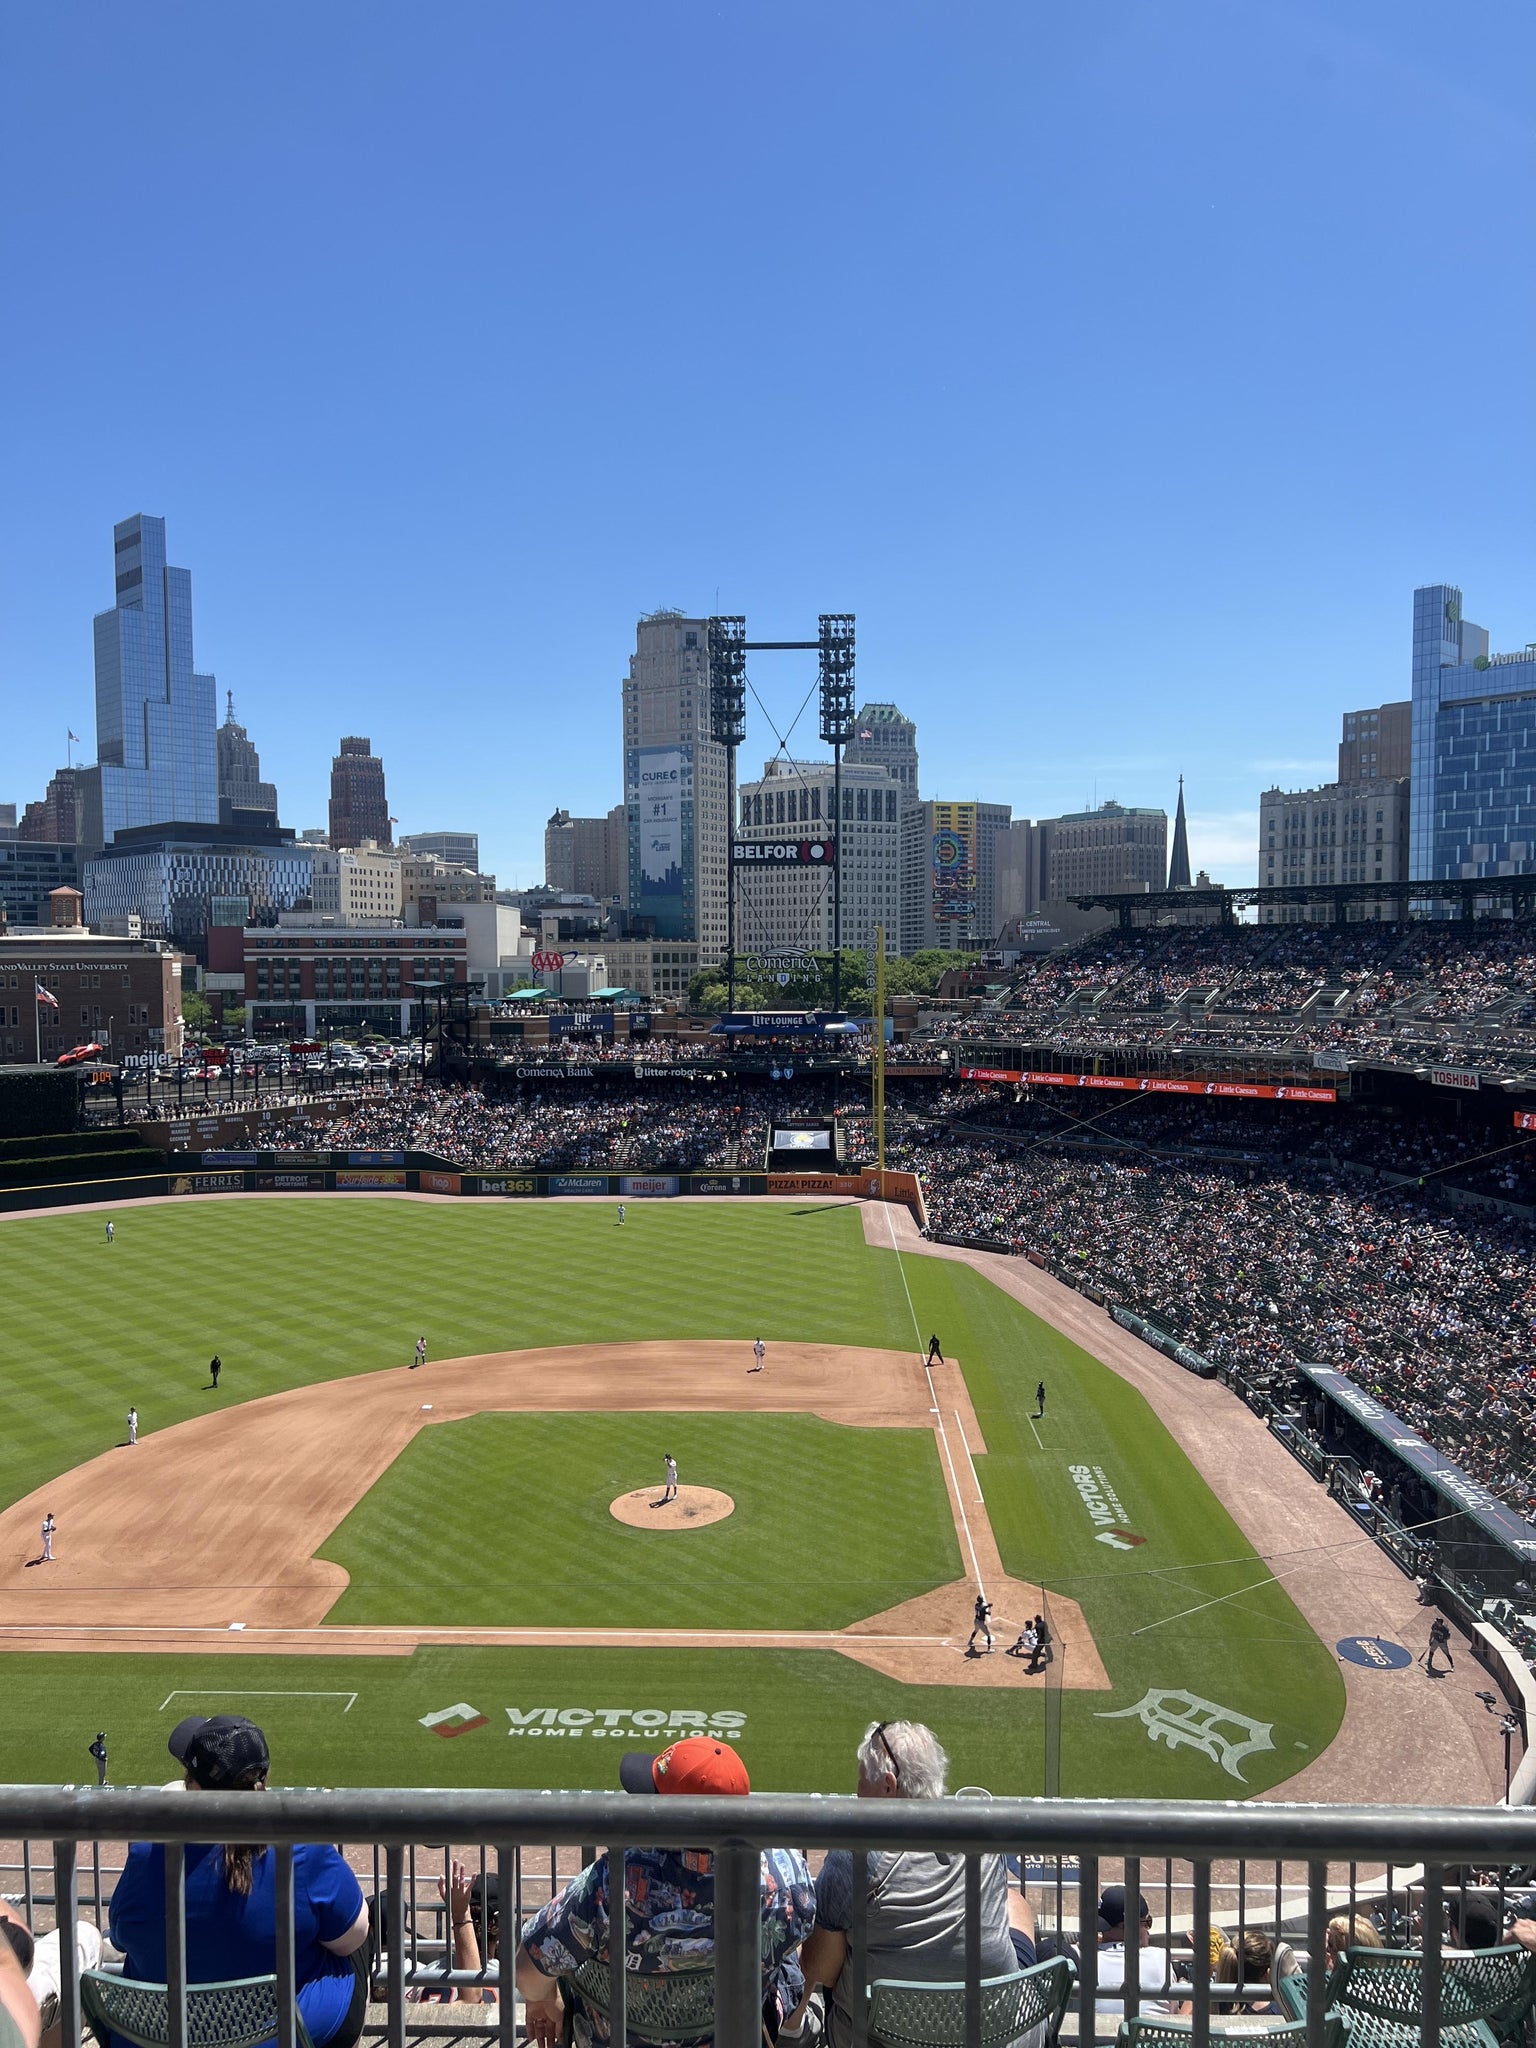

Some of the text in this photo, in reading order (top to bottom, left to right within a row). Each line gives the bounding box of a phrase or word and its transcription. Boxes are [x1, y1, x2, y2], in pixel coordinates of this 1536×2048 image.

[642, 771, 669, 781] CURE
[654, 803, 666, 816] #1
[733, 845, 798, 859] BELFOR
[533, 953, 562, 970] AAA
[747, 973, 822, 987] LANDING
[574, 1013, 591, 1026] Lite
[752, 1015, 803, 1026] Lite LOUNGE
[124, 1049, 174, 1069] meijer
[1146, 1049, 1168, 1060] CLUB
[567, 1068, 594, 1076] Bank
[644, 1067, 697, 1077] litter-robot
[990, 1071, 1008, 1079] Caesars
[1032, 1074, 1063, 1083] Little Caesars
[1090, 1077, 1124, 1087] Little Caesars
[1433, 1071, 1477, 1088] TOSHIBA
[1152, 1081, 1189, 1091] Little Caesars
[1219, 1085, 1258, 1095] Little Caesars
[1290, 1089, 1332, 1099] Little Caesars
[327, 1103, 337, 1111] 42
[262, 1112, 271, 1120] 10
[195, 1175, 241, 1187] FERRIS
[342, 1175, 379, 1185] Surfside
[567, 1179, 602, 1187] McLaren
[769, 1180, 833, 1189] PIZZA! PIZZA!
[482, 1180, 533, 1192] bet365
[632, 1179, 667, 1192] meijer
[700, 1183, 727, 1192] Corona
[894, 1187, 914, 1199] Little
[1068, 1465, 1116, 1526] VICTORS
[1092, 1465, 1131, 1524] HOME SOLUTIONS
[505, 1707, 748, 1728] VICTORS
[508, 1728, 742, 1738] HOME SOLUTIONS
